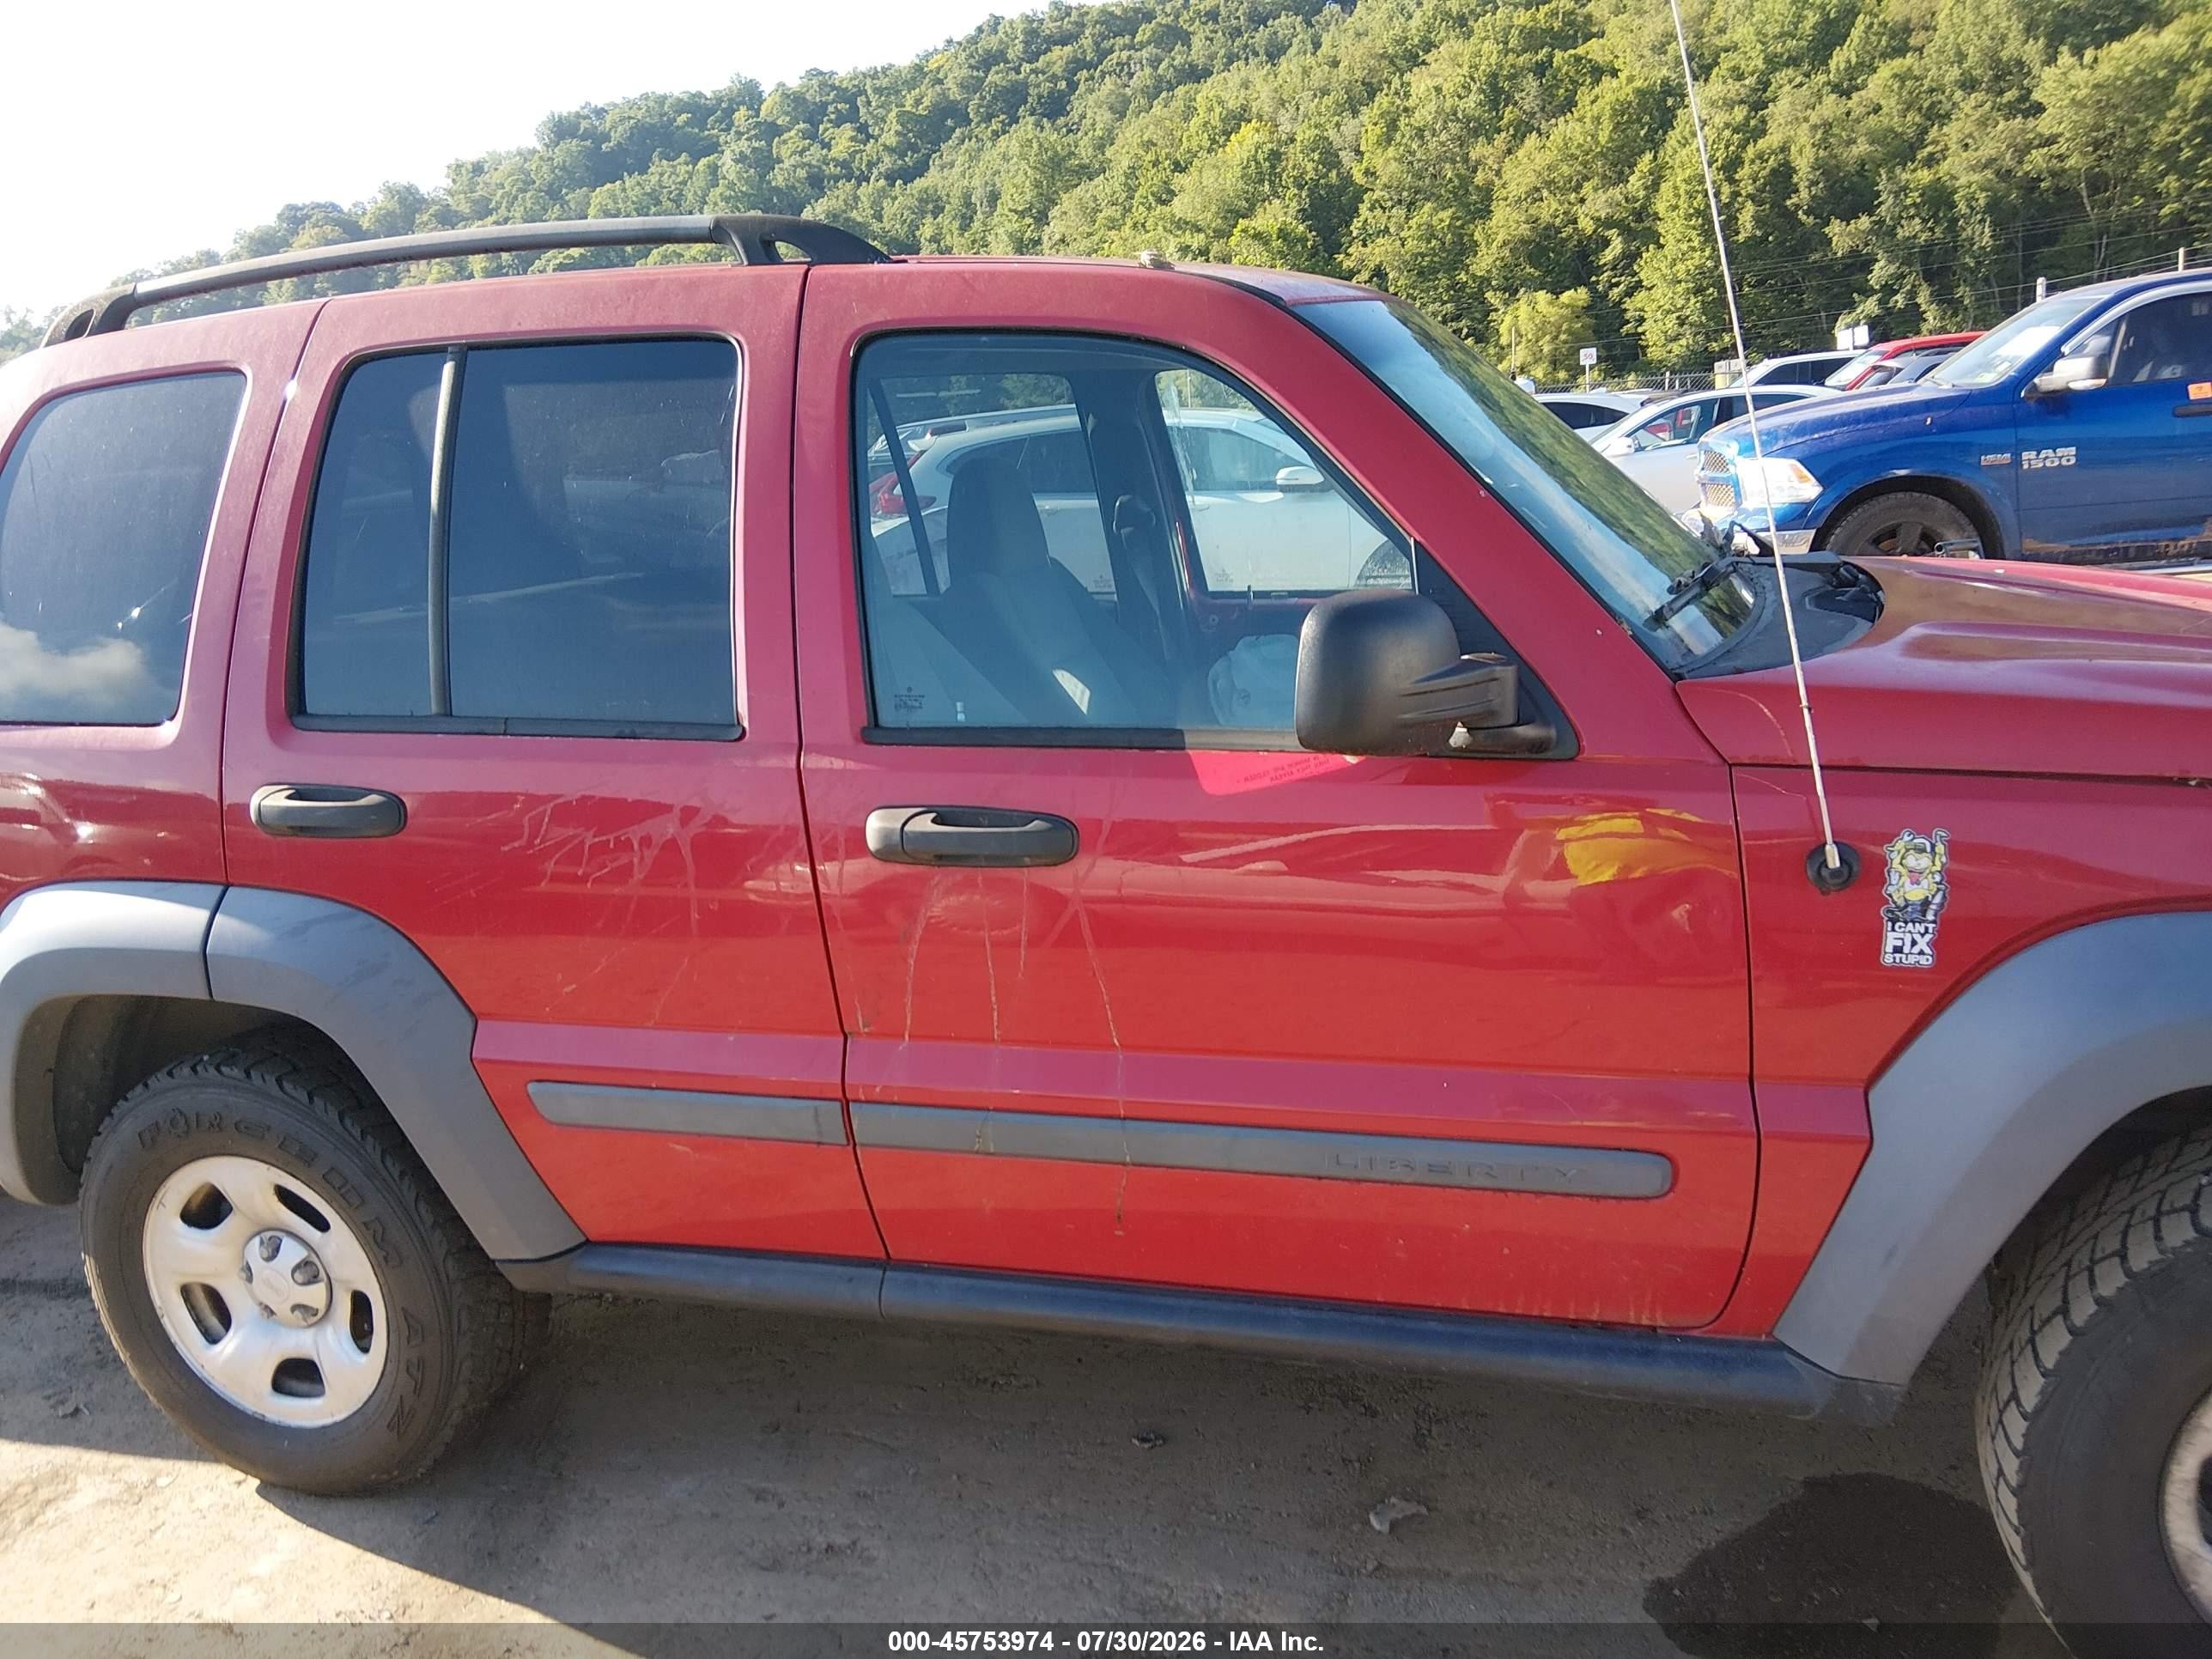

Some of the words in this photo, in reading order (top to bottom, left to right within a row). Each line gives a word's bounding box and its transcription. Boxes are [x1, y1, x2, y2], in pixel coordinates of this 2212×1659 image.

[2021, 447, 2076, 460] RAM
[2021, 456, 2076, 470] 1500
[1887, 921, 1892, 932] I
[1885, 932, 1934, 955] FIX
[1884, 953, 1933, 964] STUPID
[1327, 1153, 1580, 1183] LIBERTY
